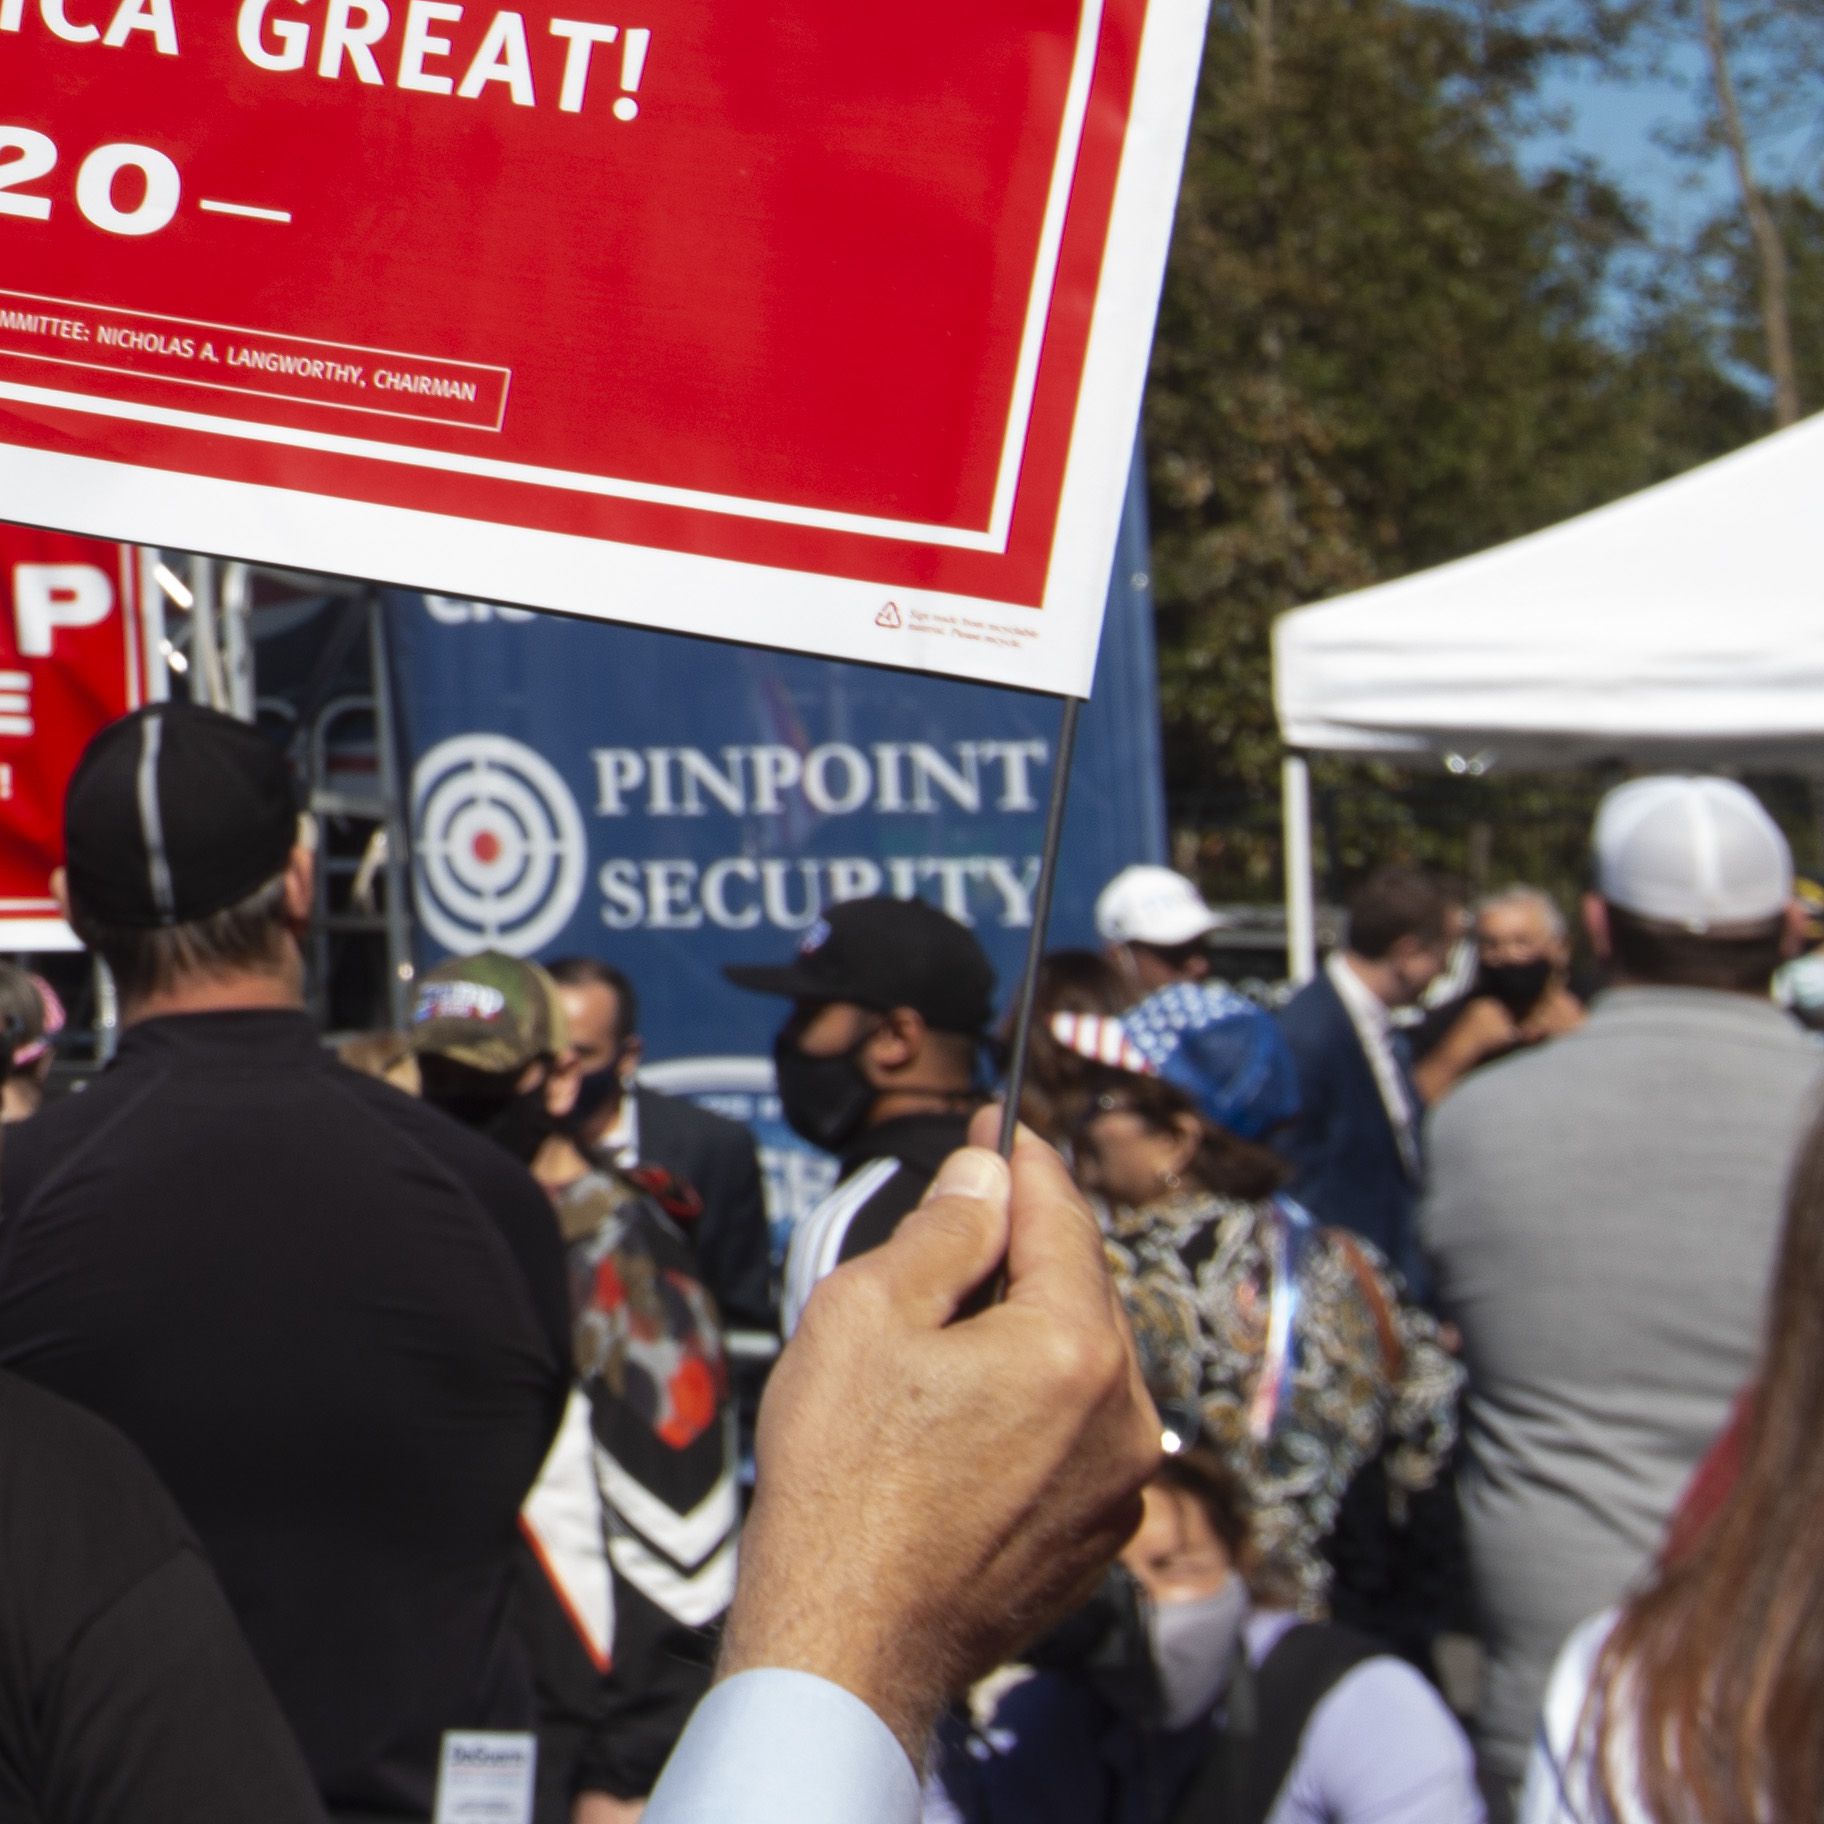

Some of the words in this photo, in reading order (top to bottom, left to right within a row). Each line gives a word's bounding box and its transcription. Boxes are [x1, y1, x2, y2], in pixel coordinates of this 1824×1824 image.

[96, 324, 196, 360] NICHOLAS
[199, 342, 220, 364] A.
[226, 345, 368, 388] LANGWORTHY,
[372, 368, 478, 403] CHAIRMAN
[593, 740, 1049, 816] PINPOINT
